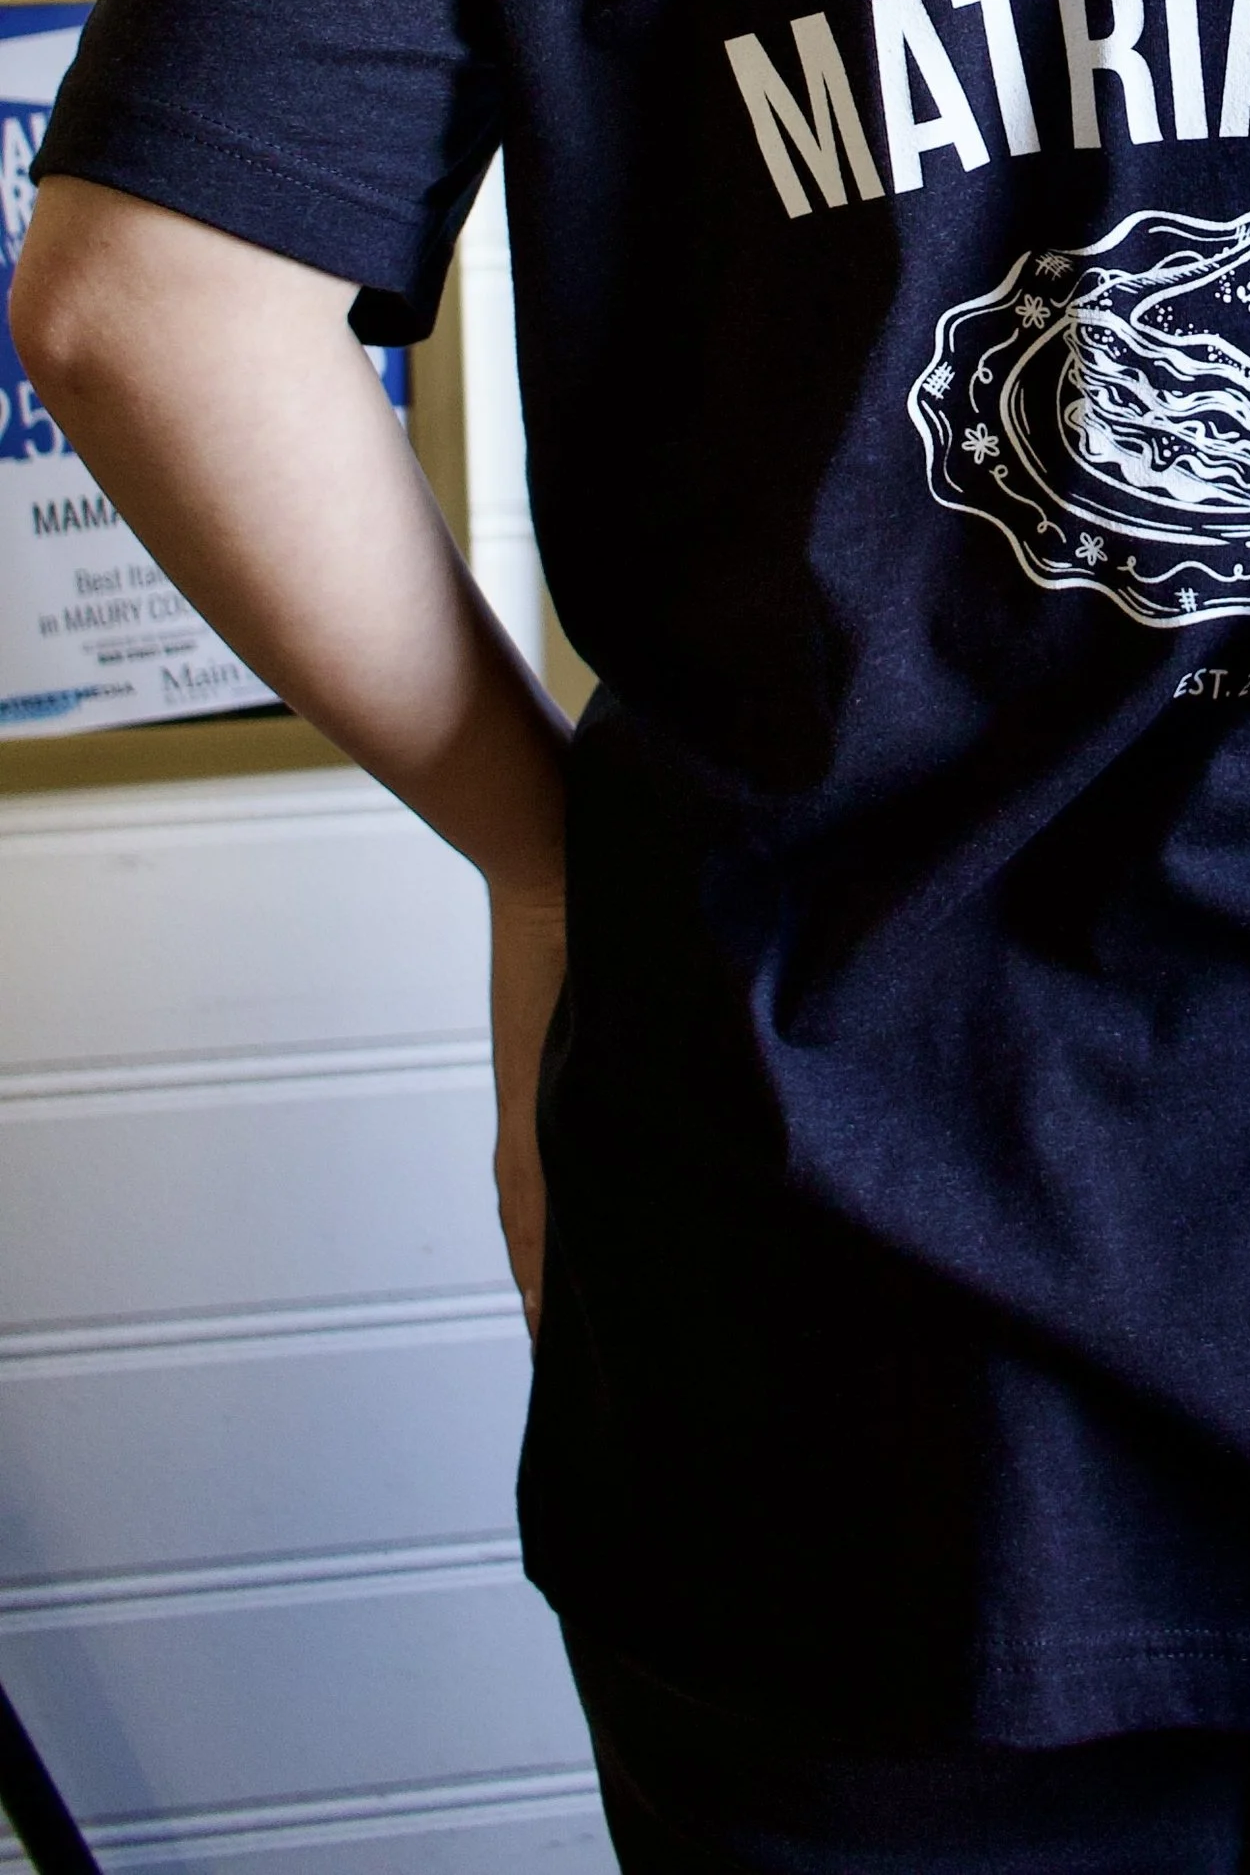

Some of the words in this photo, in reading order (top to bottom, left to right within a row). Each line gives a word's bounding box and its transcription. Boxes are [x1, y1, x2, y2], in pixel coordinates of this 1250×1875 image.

[33, 493, 118, 537] MAM
[76, 567, 121, 595] Best
[64, 599, 142, 632] MAURY
[161, 662, 240, 693] Main
[1173, 668, 1230, 700] EST.
